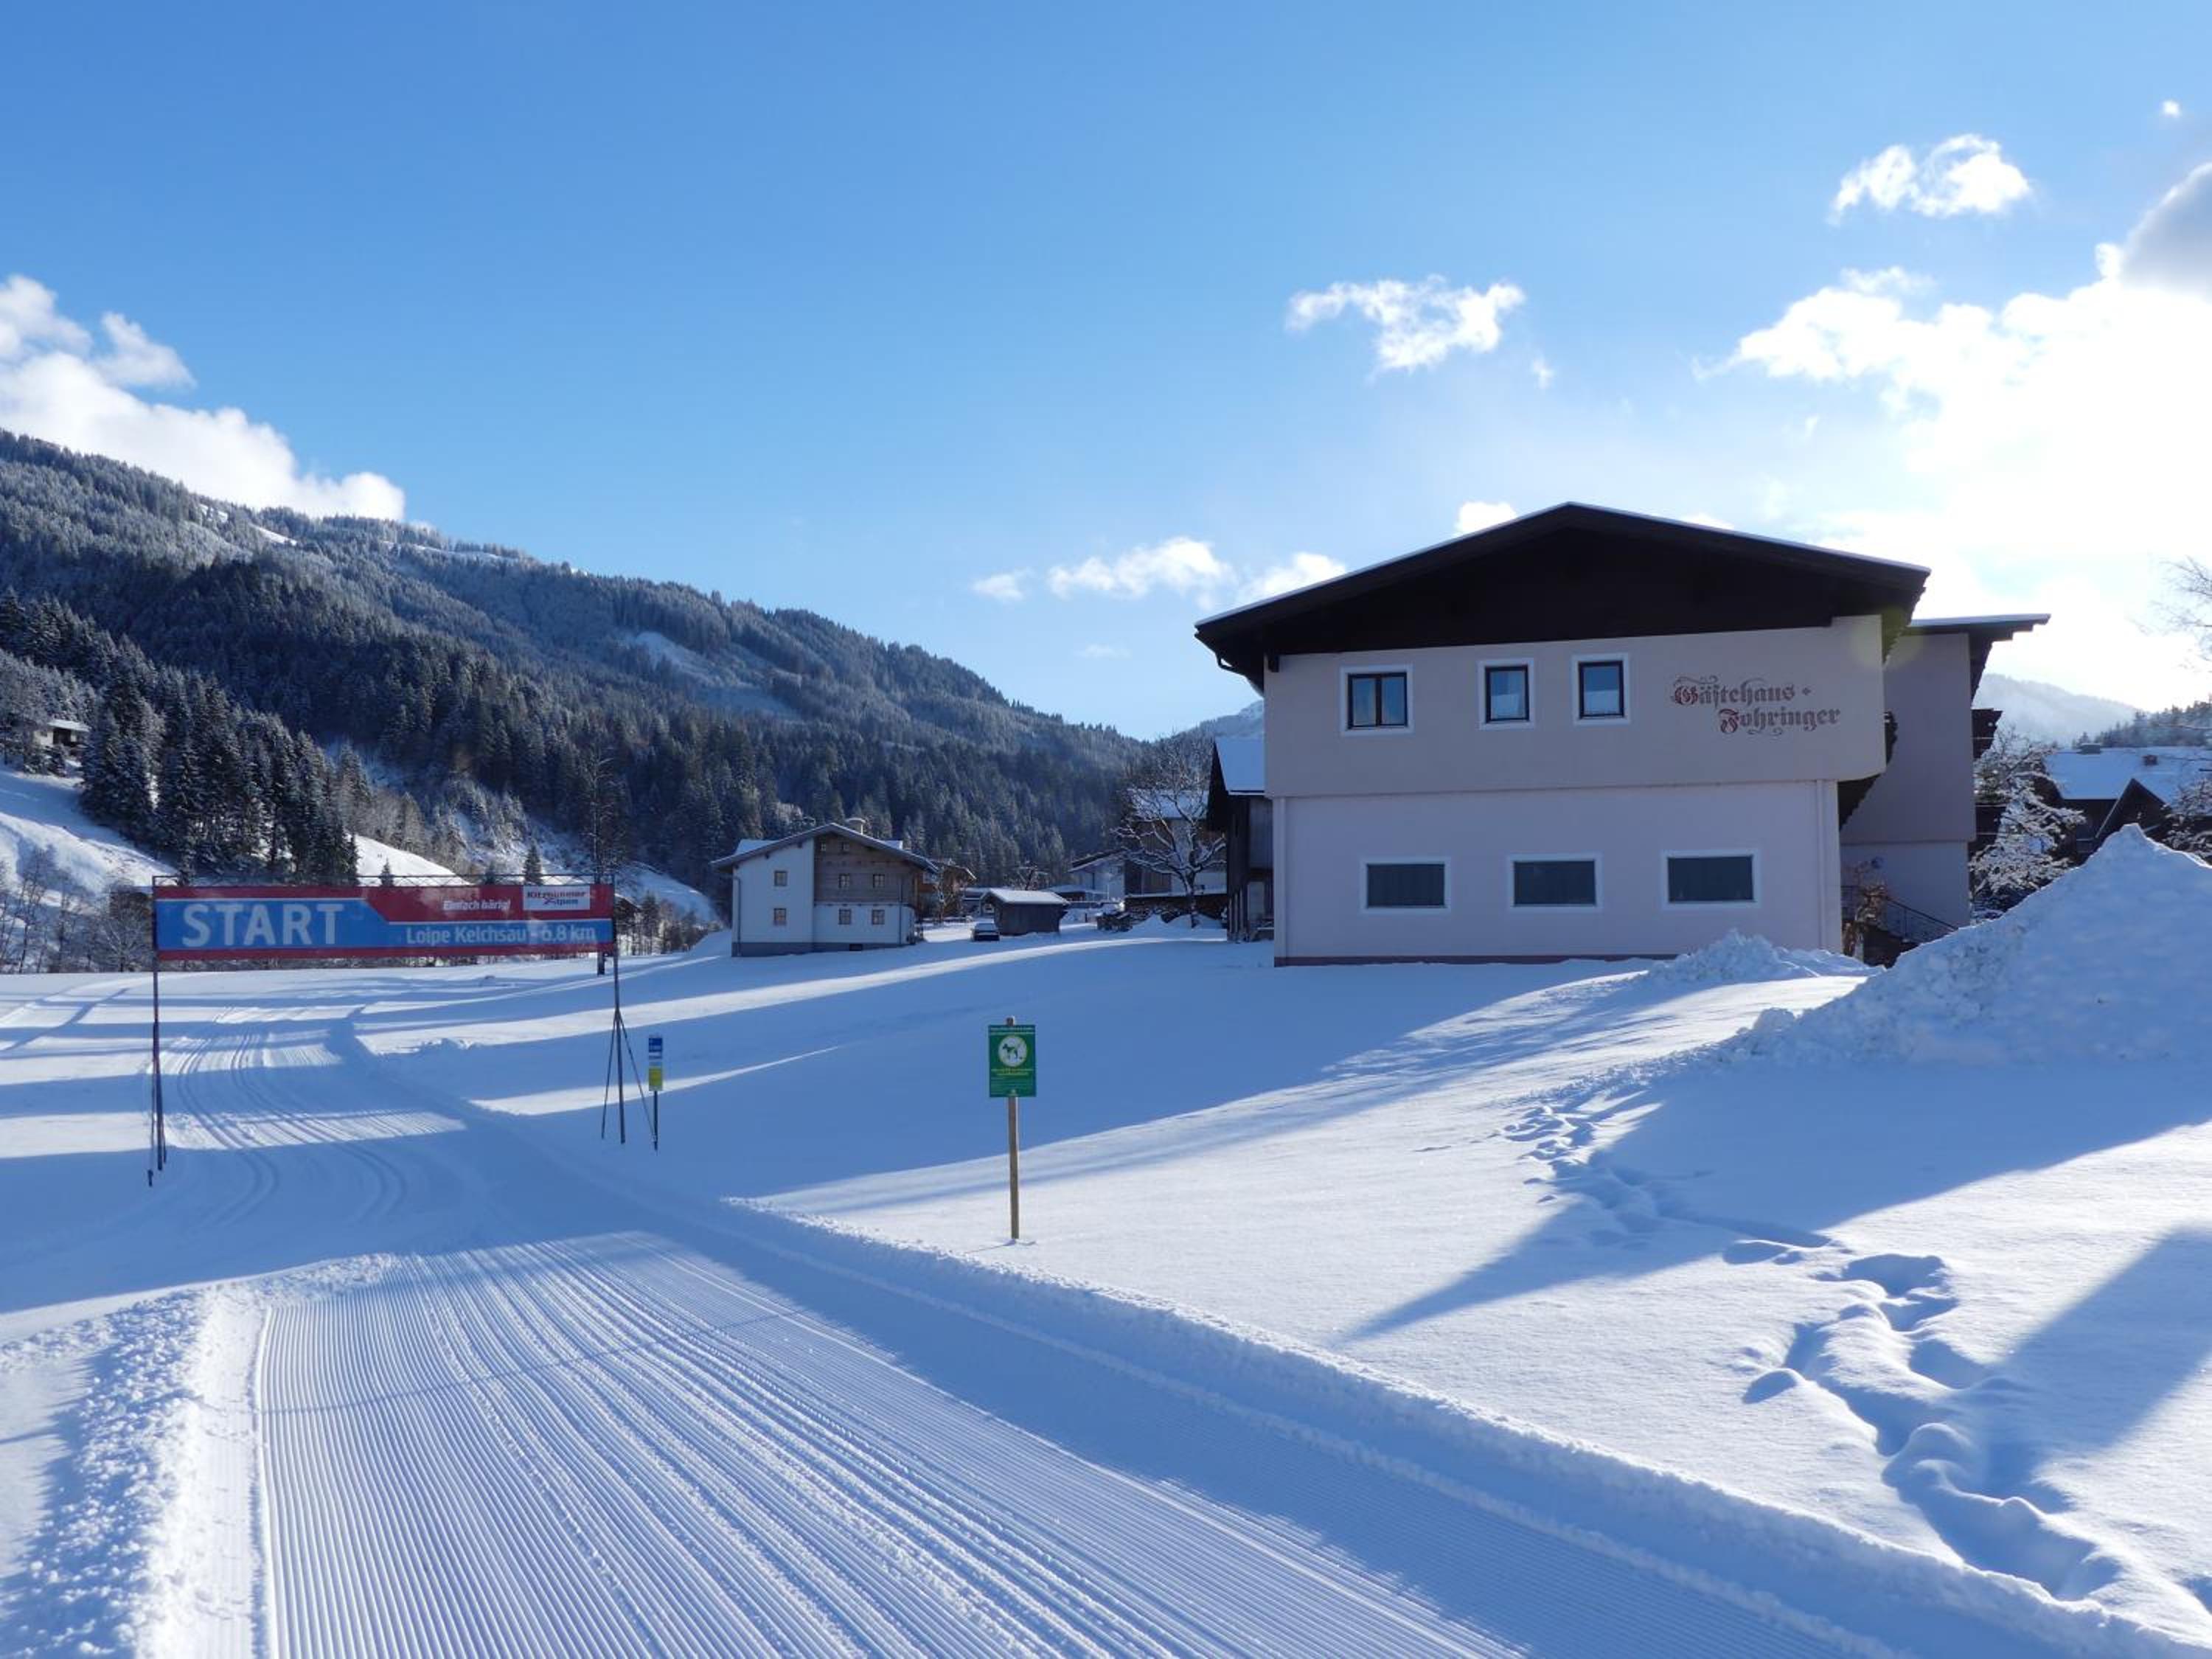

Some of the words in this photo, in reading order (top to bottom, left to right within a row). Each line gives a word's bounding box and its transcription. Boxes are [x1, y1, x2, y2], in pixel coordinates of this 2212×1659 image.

[443, 900, 479, 911] Einfach
[181, 902, 345, 948] START
[406, 925, 450, 945] Loipe
[455, 925, 526, 944] Kelchsau
[571, 923, 597, 941] km
